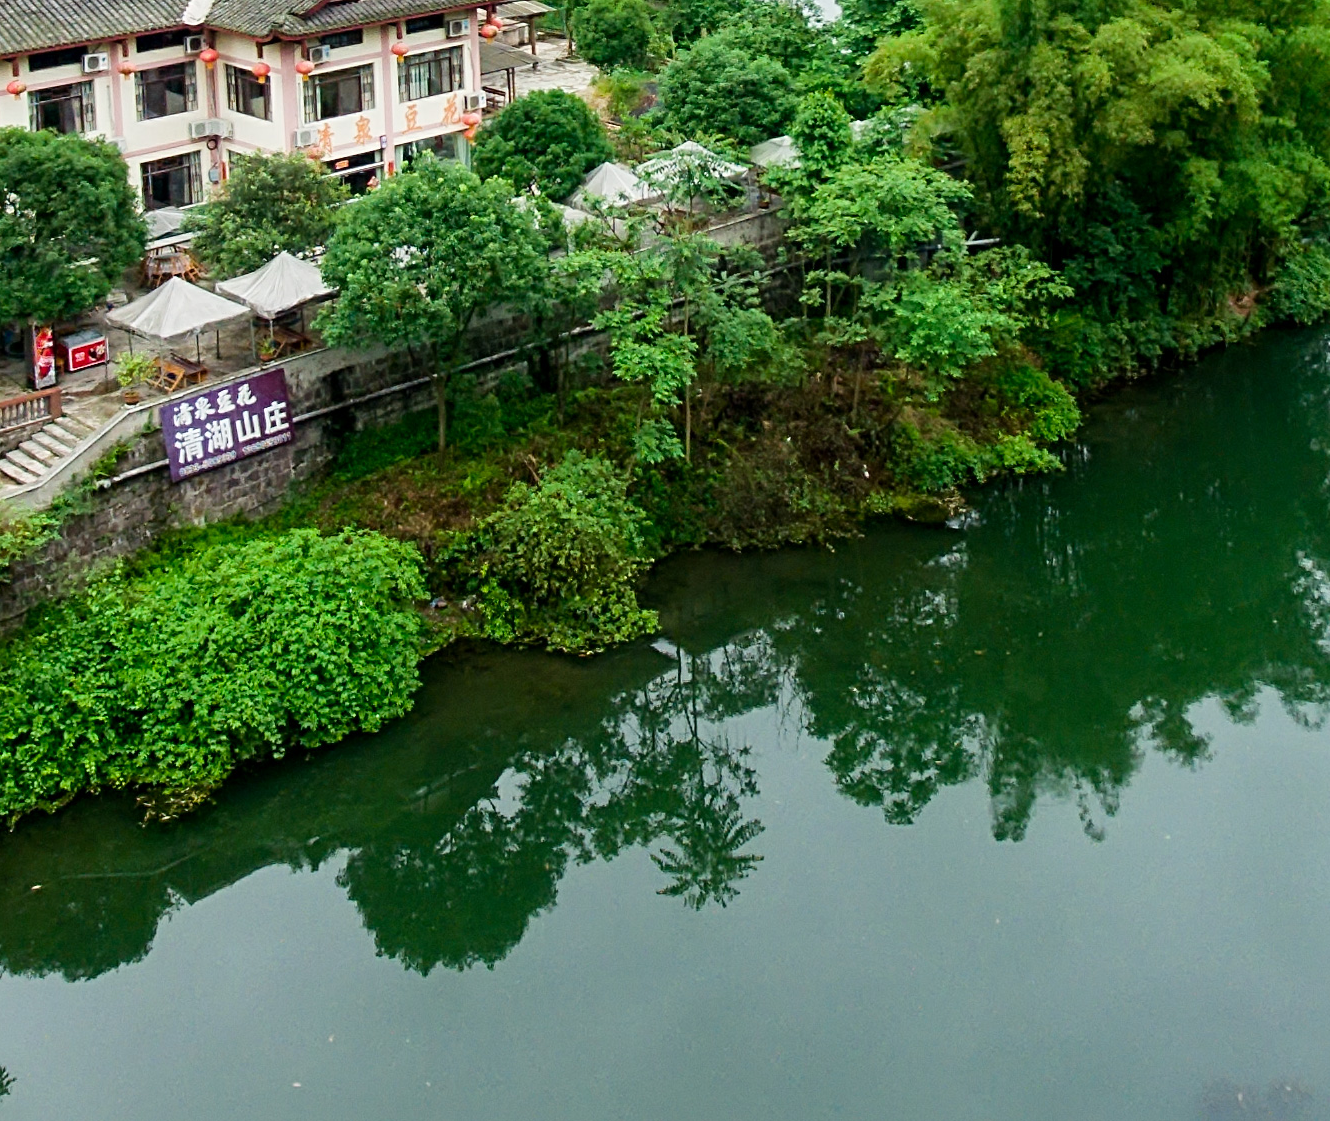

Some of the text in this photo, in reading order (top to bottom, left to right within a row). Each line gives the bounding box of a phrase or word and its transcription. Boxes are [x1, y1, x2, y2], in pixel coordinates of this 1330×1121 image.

[316, 93, 462, 157] 清泉豆花
[172, 383, 258, 428] 清泉豆花
[173, 400, 290, 465] 清湖山庄
